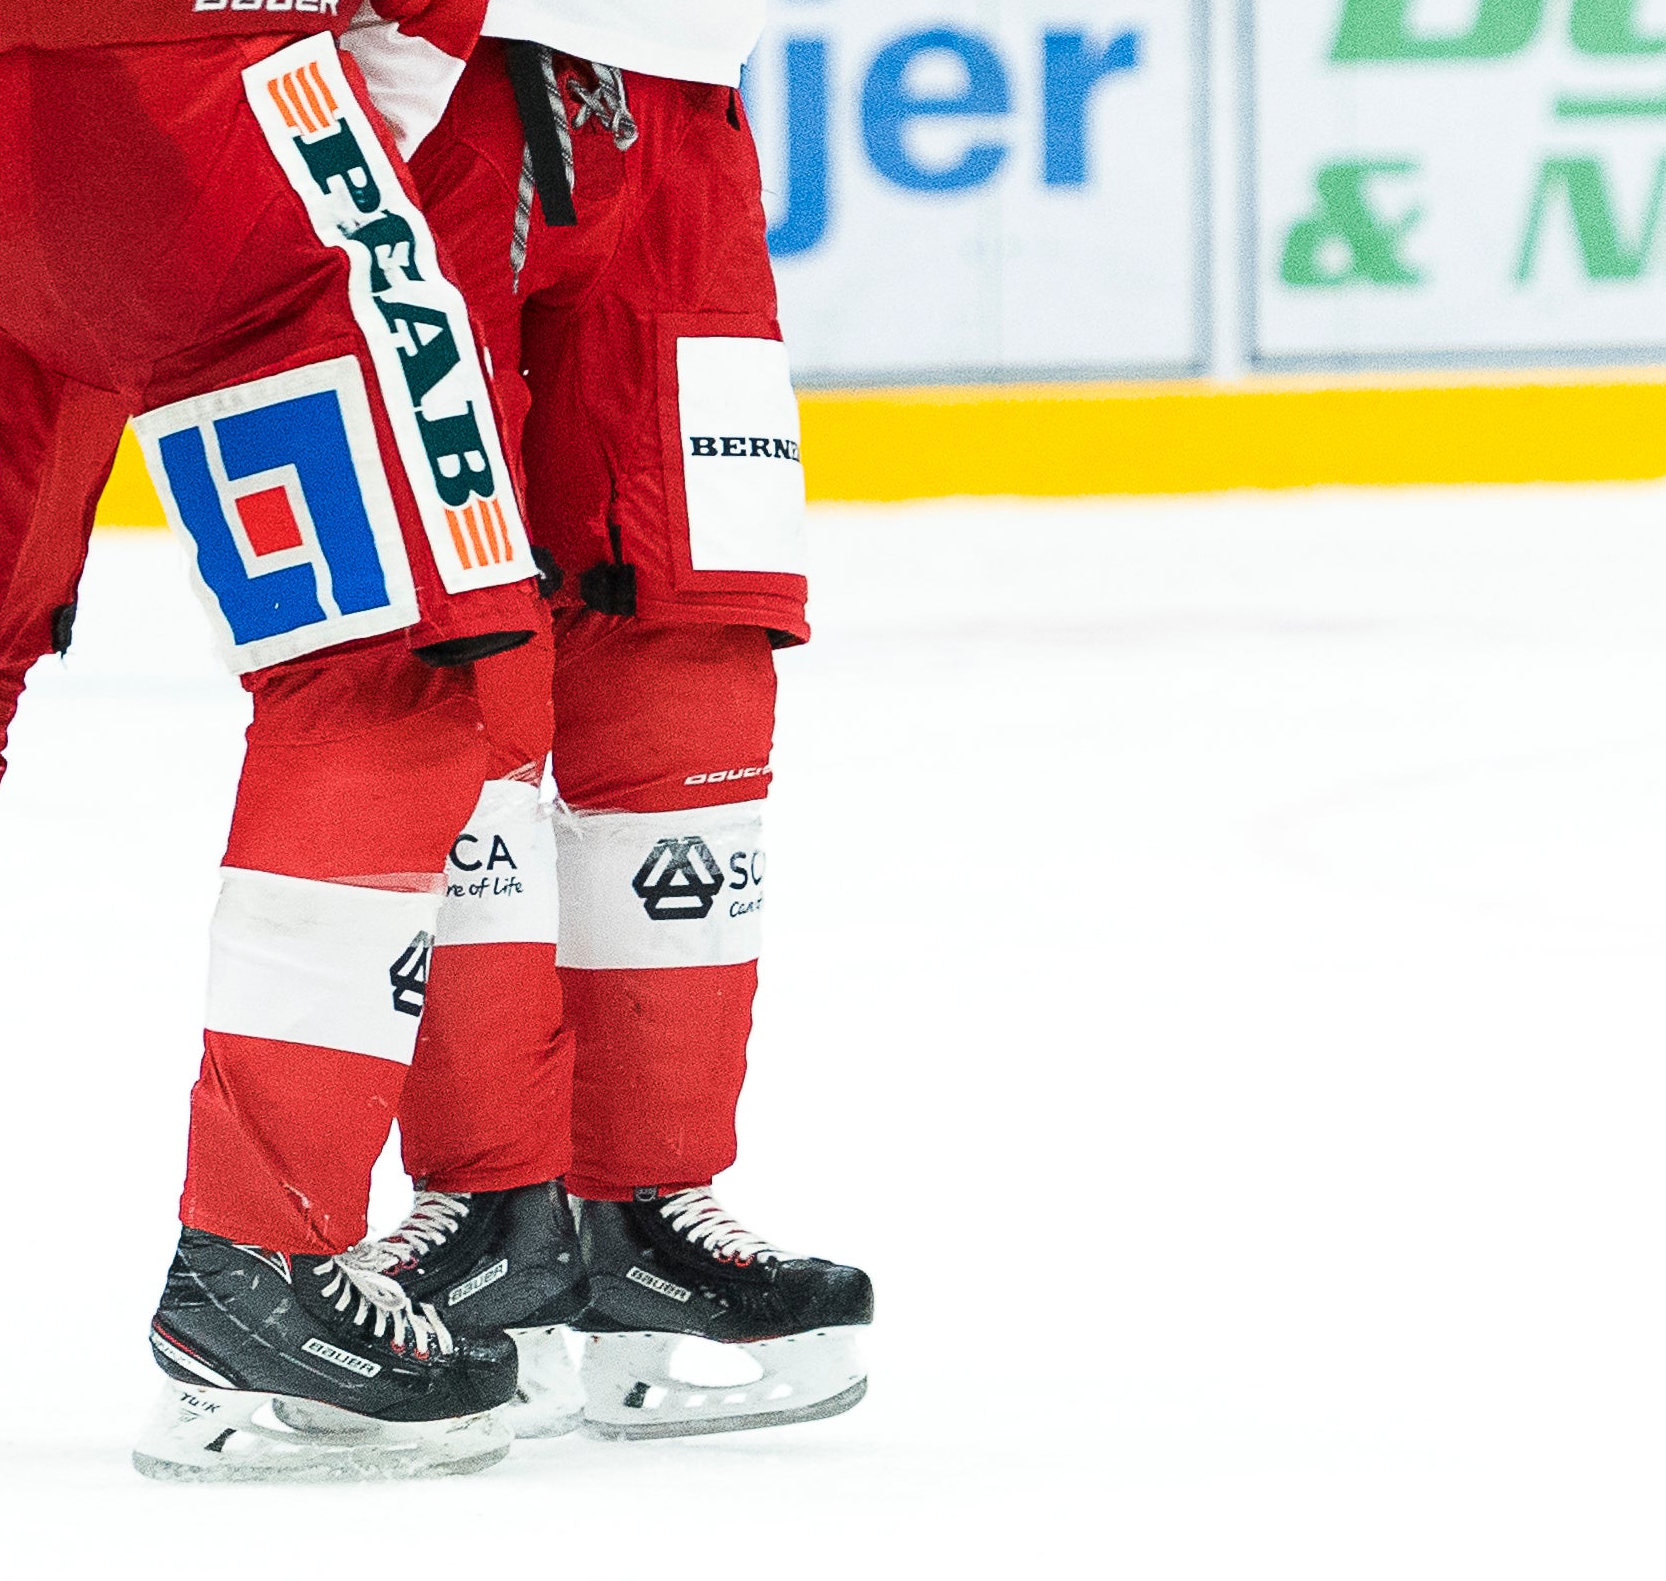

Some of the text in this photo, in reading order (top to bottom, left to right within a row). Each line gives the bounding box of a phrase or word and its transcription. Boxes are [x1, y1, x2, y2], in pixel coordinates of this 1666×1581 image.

[1279, 156, 1427, 290] &
[293, 117, 496, 507] PEAB
[449, 834, 517, 871] CA
[729, 850, 765, 890] SC
[494, 877, 524, 896] Life
[309, 1340, 375, 1375] BAUER
